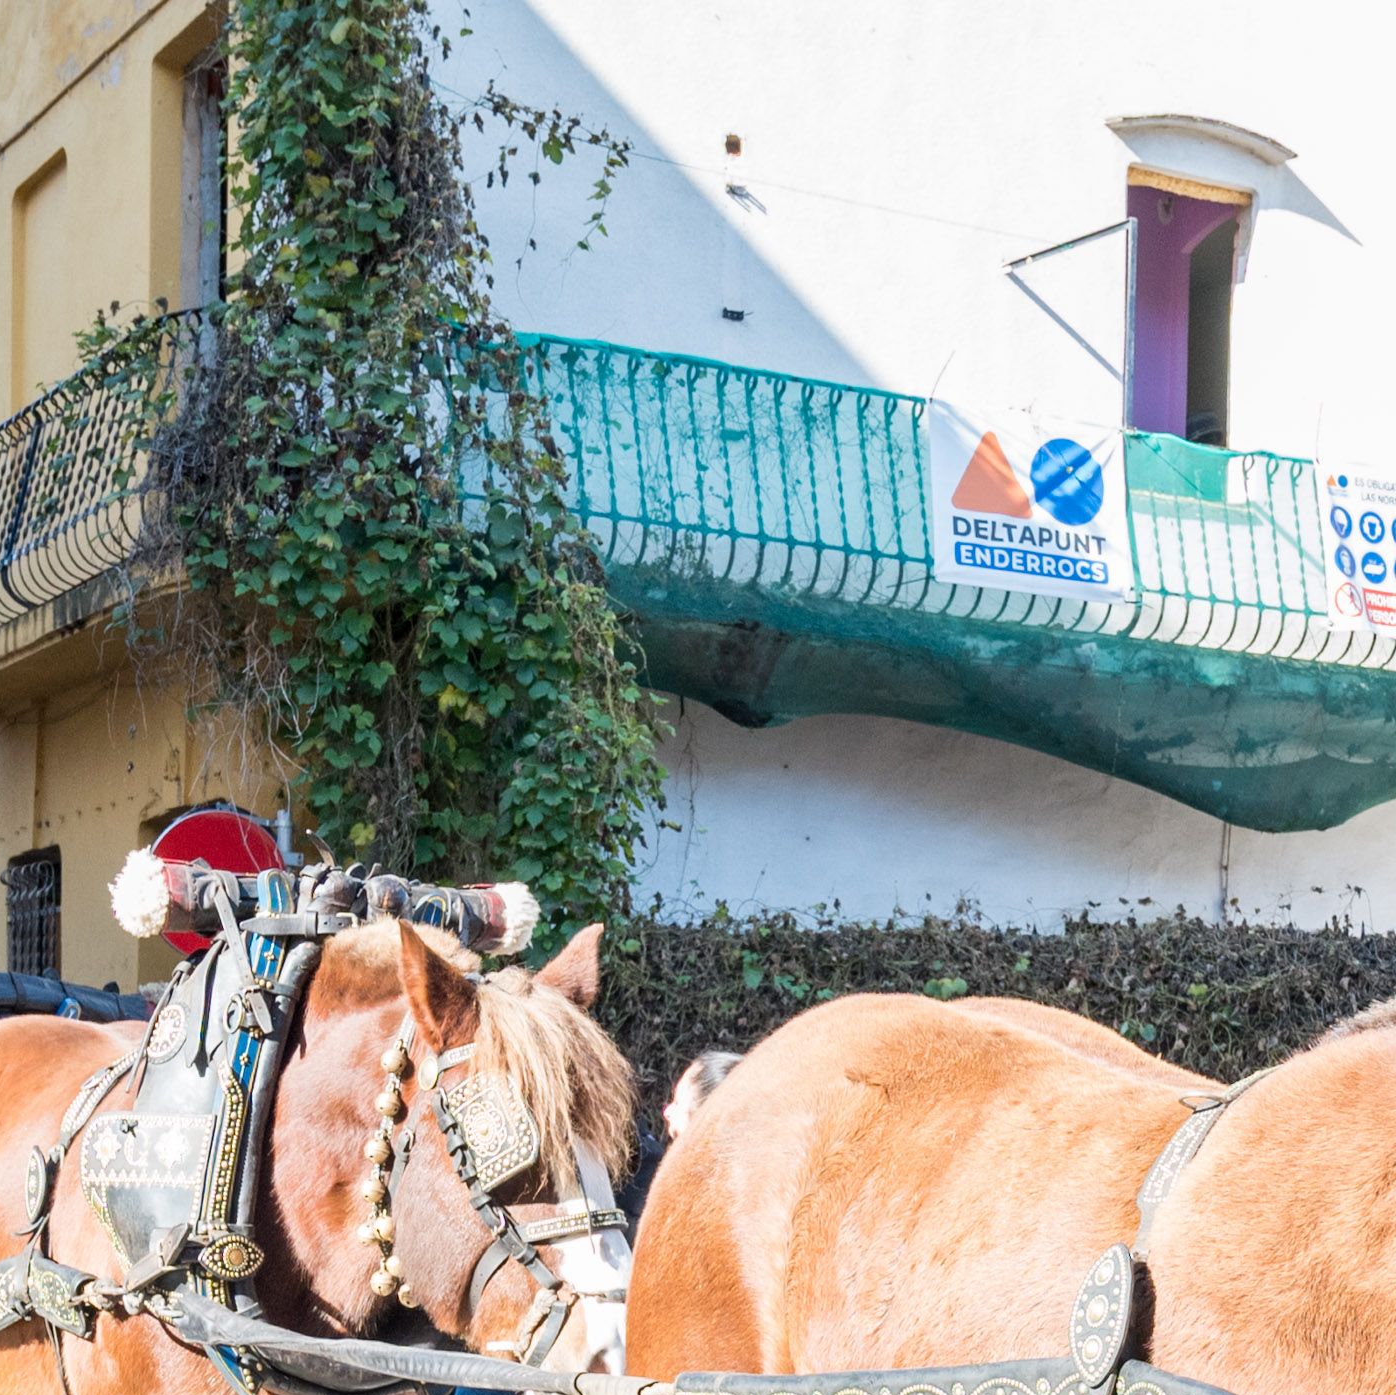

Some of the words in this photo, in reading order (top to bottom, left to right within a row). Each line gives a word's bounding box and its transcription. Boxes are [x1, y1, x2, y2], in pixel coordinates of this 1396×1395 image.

[1354, 477, 1365, 488] ES
[1361, 492, 1376, 503] LAS
[952, 515, 1106, 556] DELTAPUNT
[960, 544, 1106, 582] ENDERROCS
